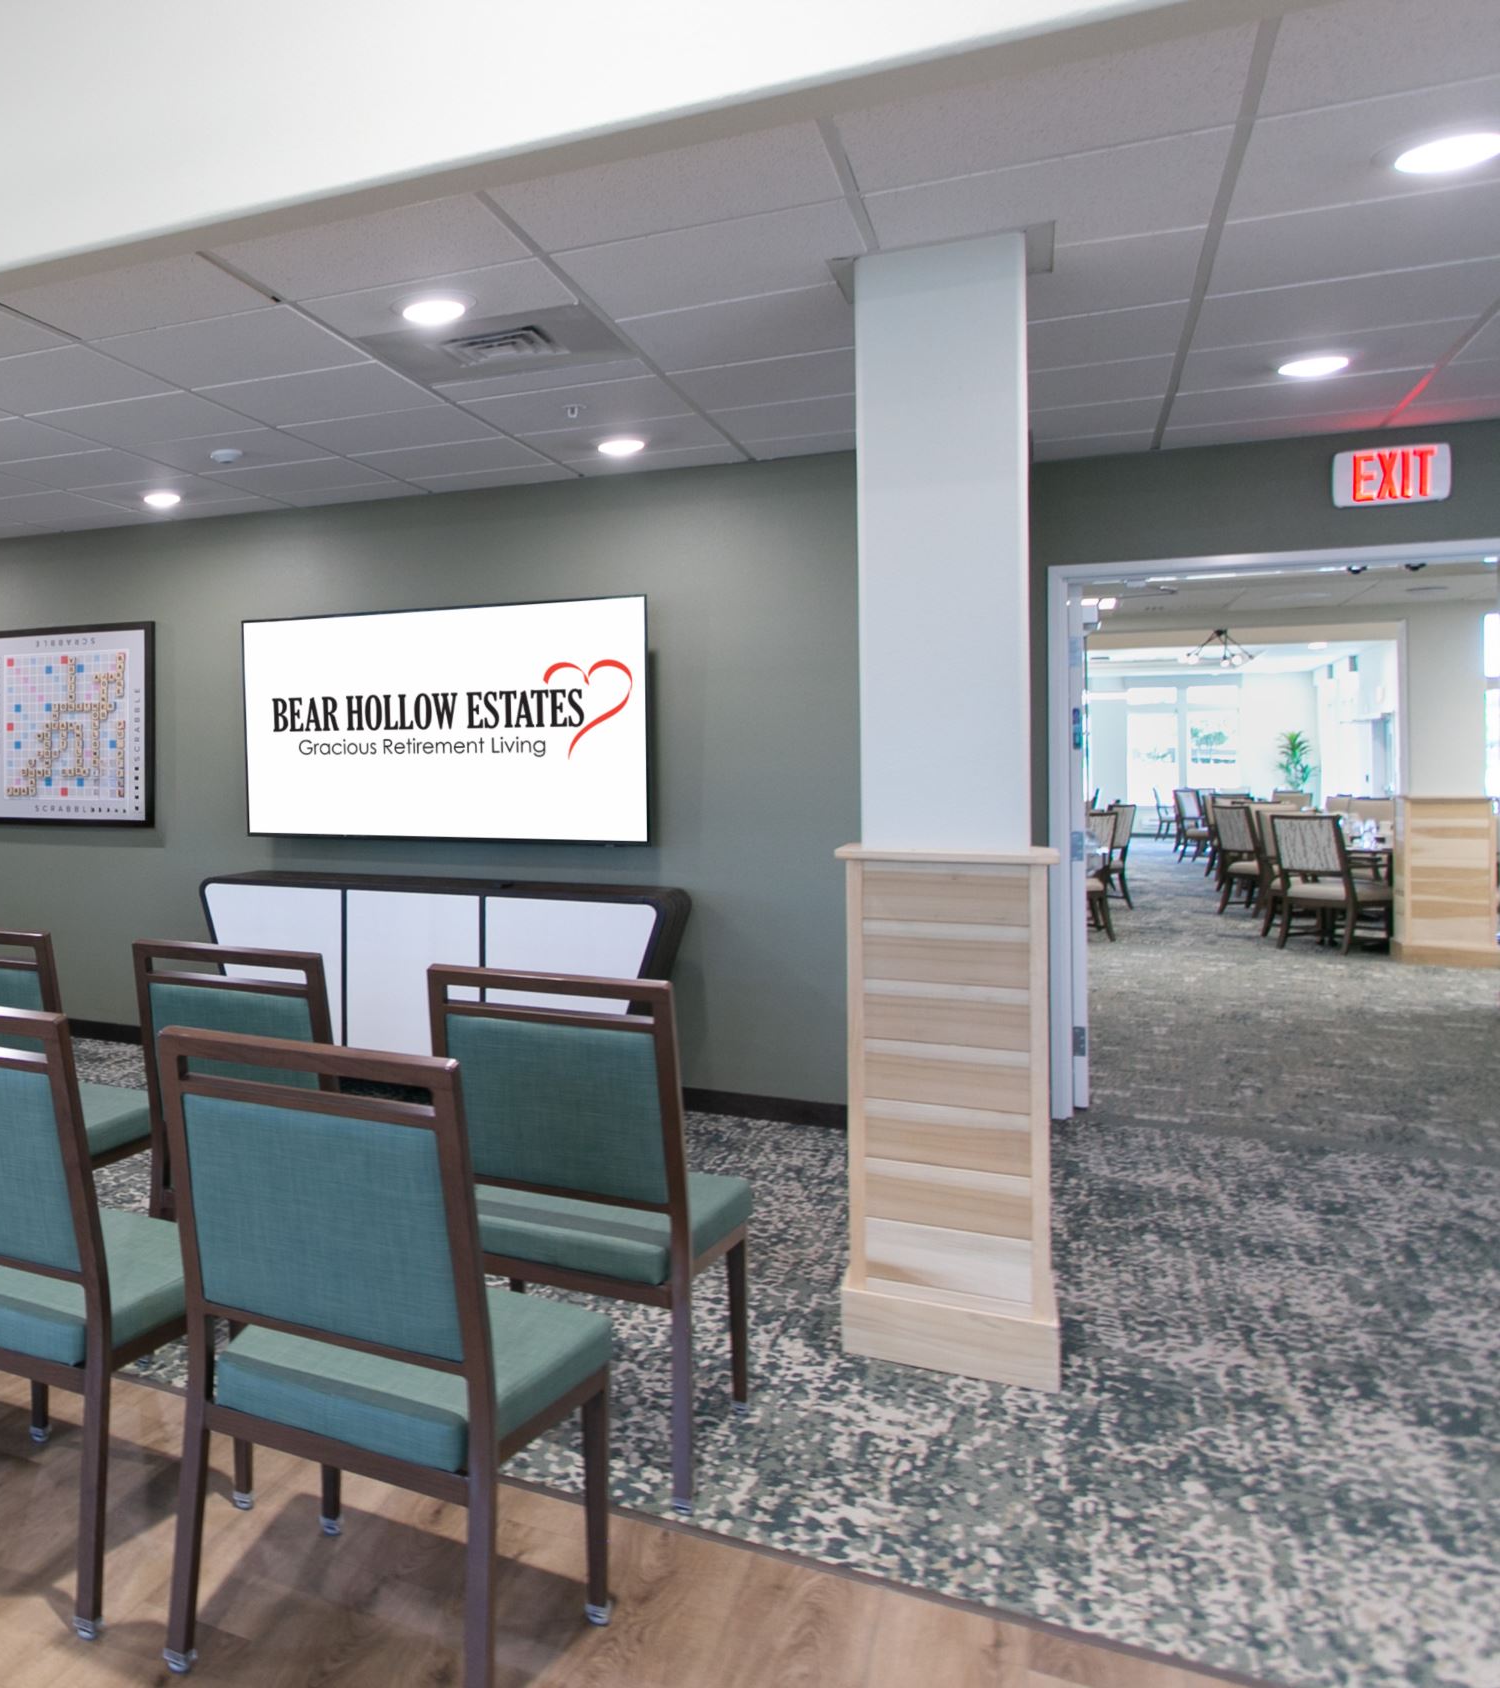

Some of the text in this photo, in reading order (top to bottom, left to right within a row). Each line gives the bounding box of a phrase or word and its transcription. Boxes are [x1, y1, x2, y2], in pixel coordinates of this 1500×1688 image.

[1352, 445, 1438, 502] EXIT
[272, 688, 585, 732] BEAR HOLLOW ESTATES
[298, 736, 547, 758] Gracious Retirement Living
